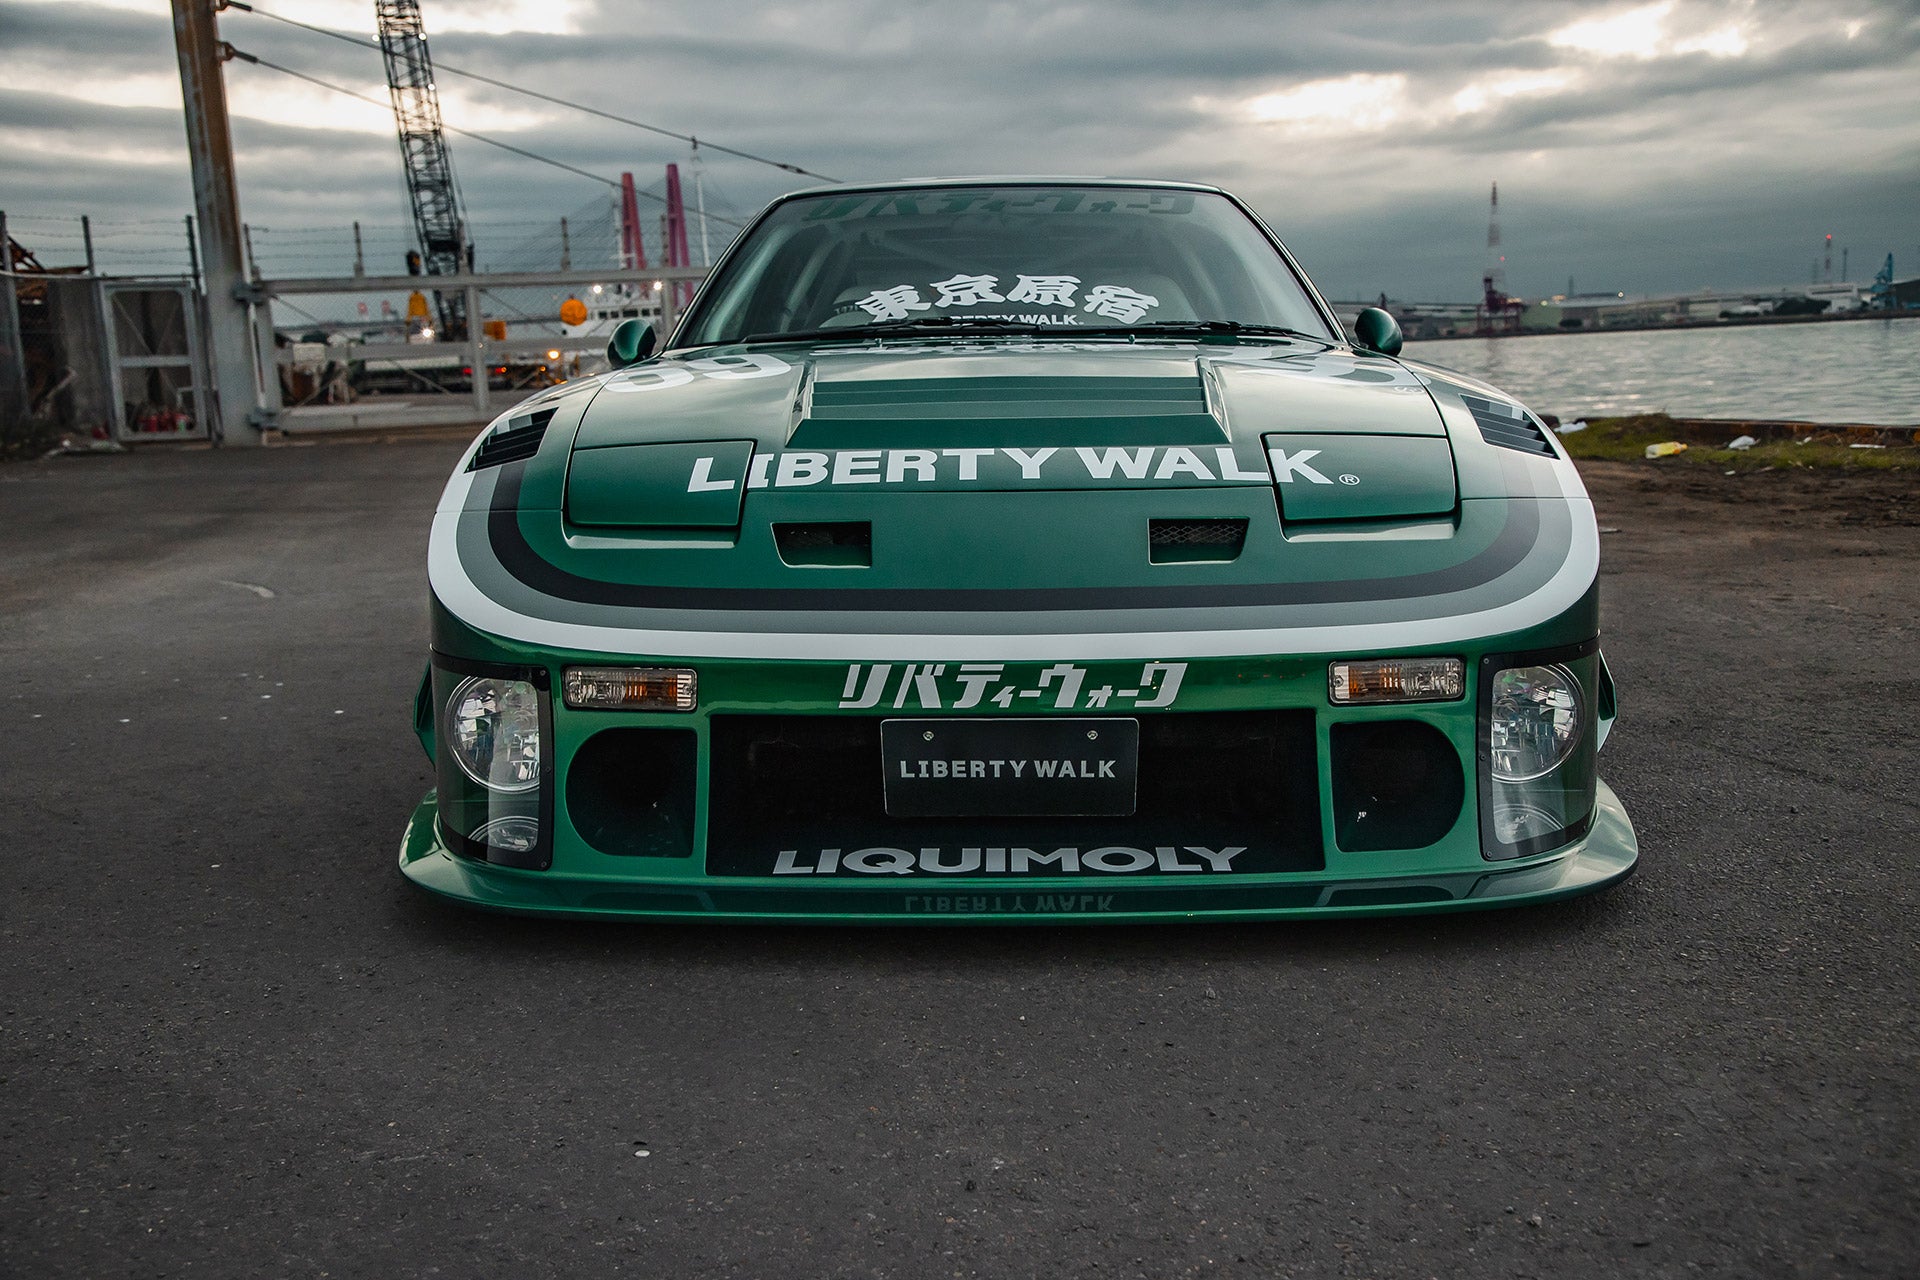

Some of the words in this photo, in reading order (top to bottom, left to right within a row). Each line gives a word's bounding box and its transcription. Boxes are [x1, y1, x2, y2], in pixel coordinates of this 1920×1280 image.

[855, 274, 1159, 324] 東京原宿
[687, 447, 1060, 493] LIBERTY
[1074, 447, 1334, 484] WALK
[838, 663, 1188, 709] リバティーウォーク
[900, 760, 1028, 778] LIBERTY
[1034, 760, 1116, 778] WALK
[772, 847, 1248, 874] LIQUIMOLY
